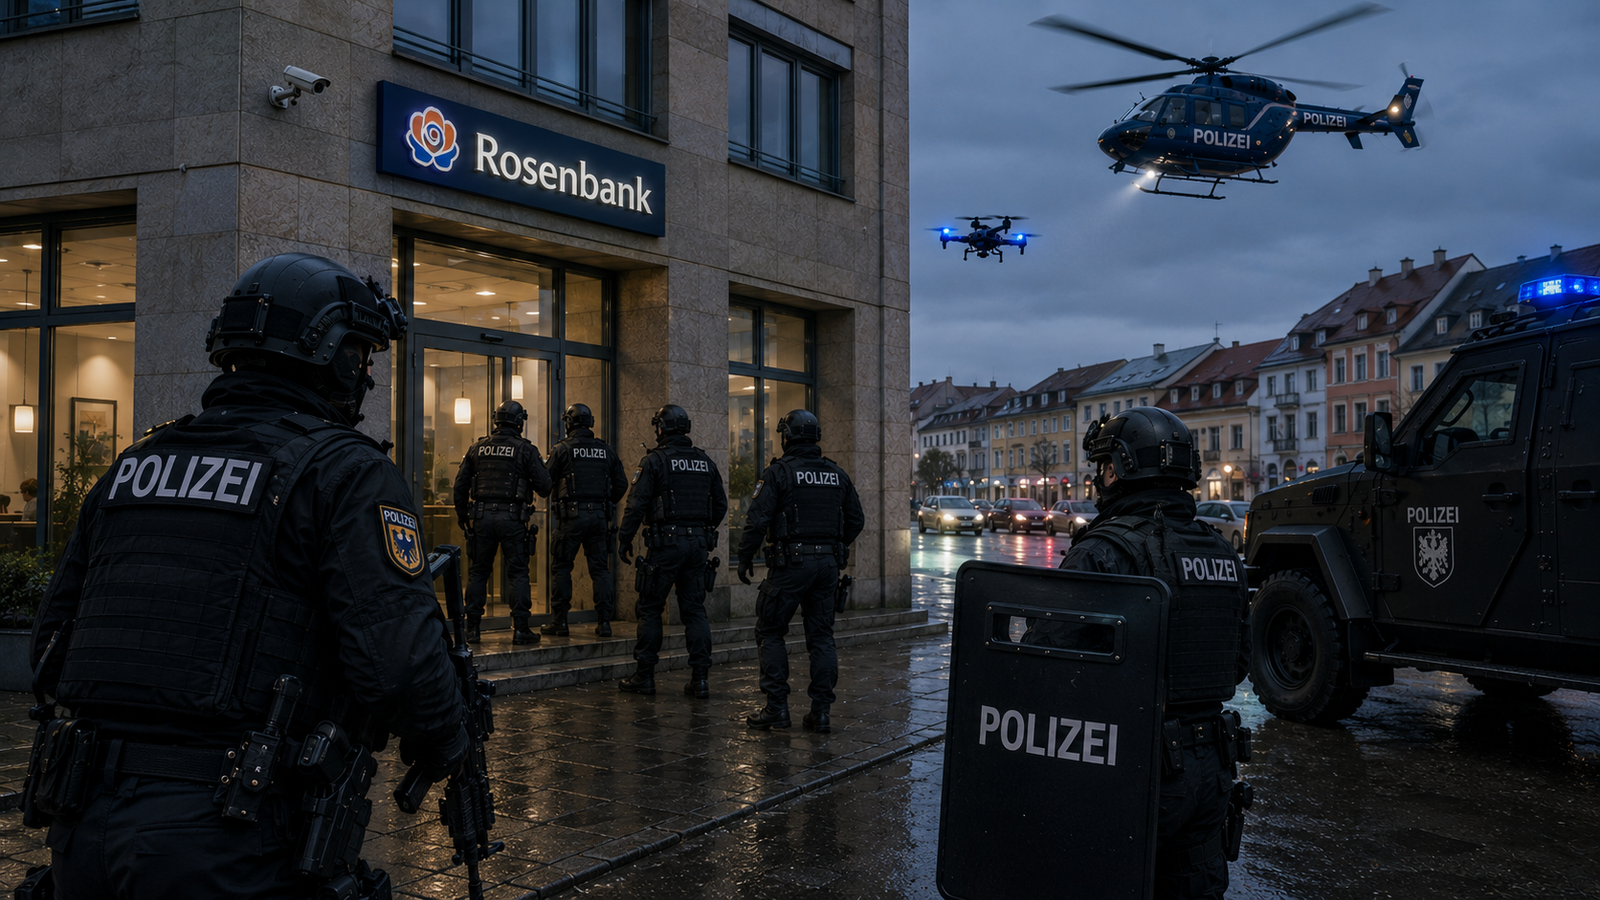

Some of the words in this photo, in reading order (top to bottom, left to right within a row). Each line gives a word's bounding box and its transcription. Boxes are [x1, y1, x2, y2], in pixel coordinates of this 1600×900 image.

[1303, 112, 1347, 128] POLIZEI
[1193, 128, 1251, 150] POLIZEI
[476, 132, 652, 215] Rosenbank
[478, 445, 515, 458] POLIZEI
[573, 447, 607, 459] POLIZEI
[671, 459, 709, 472] POLIZEI
[108, 454, 263, 506] POLIZEI
[796, 471, 840, 486] POLIZEI
[383, 510, 416, 529] POLIZEI
[1407, 506, 1459, 524] POLIZEI
[1181, 557, 1238, 582] POLIZEI
[979, 705, 1118, 766] POLIZEI
